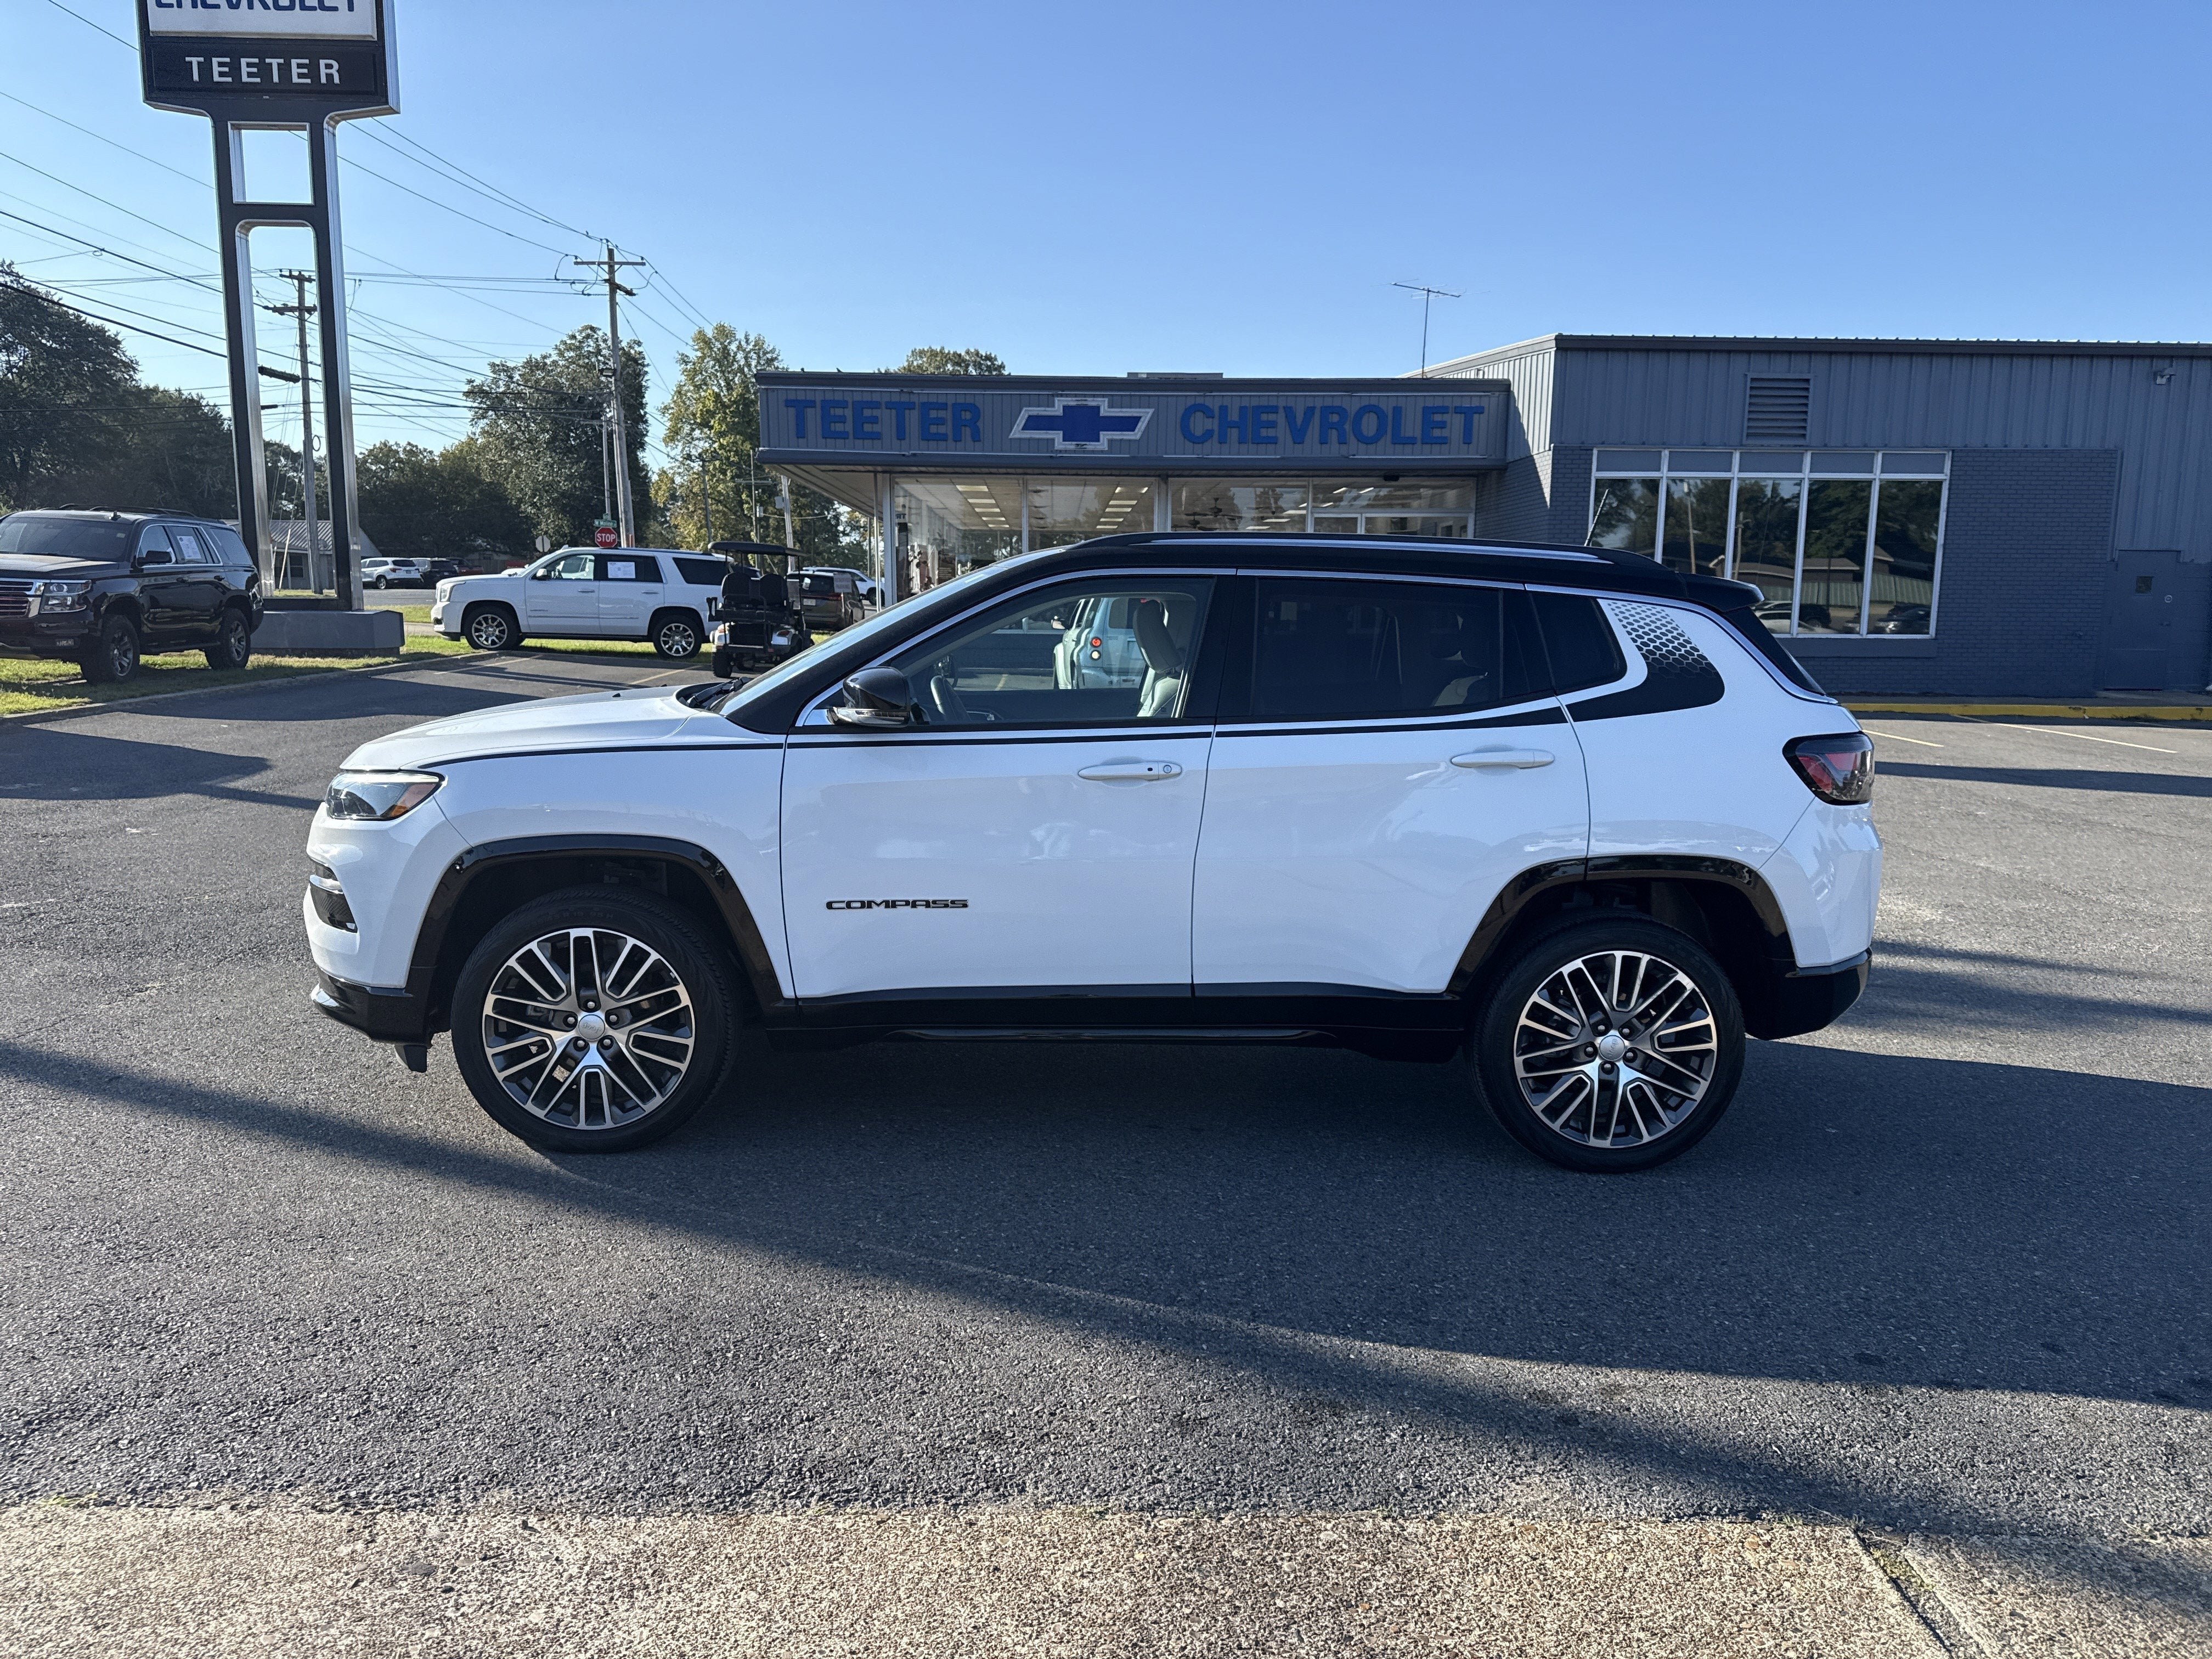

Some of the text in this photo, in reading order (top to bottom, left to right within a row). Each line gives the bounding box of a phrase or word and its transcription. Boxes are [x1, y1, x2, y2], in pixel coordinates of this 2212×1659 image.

[185, 57, 340, 84] TEETER
[785, 398, 1485, 445] TEETER CHEVROLET
[596, 533, 616, 543] STOP
[826, 899, 968, 910] COMPASS
